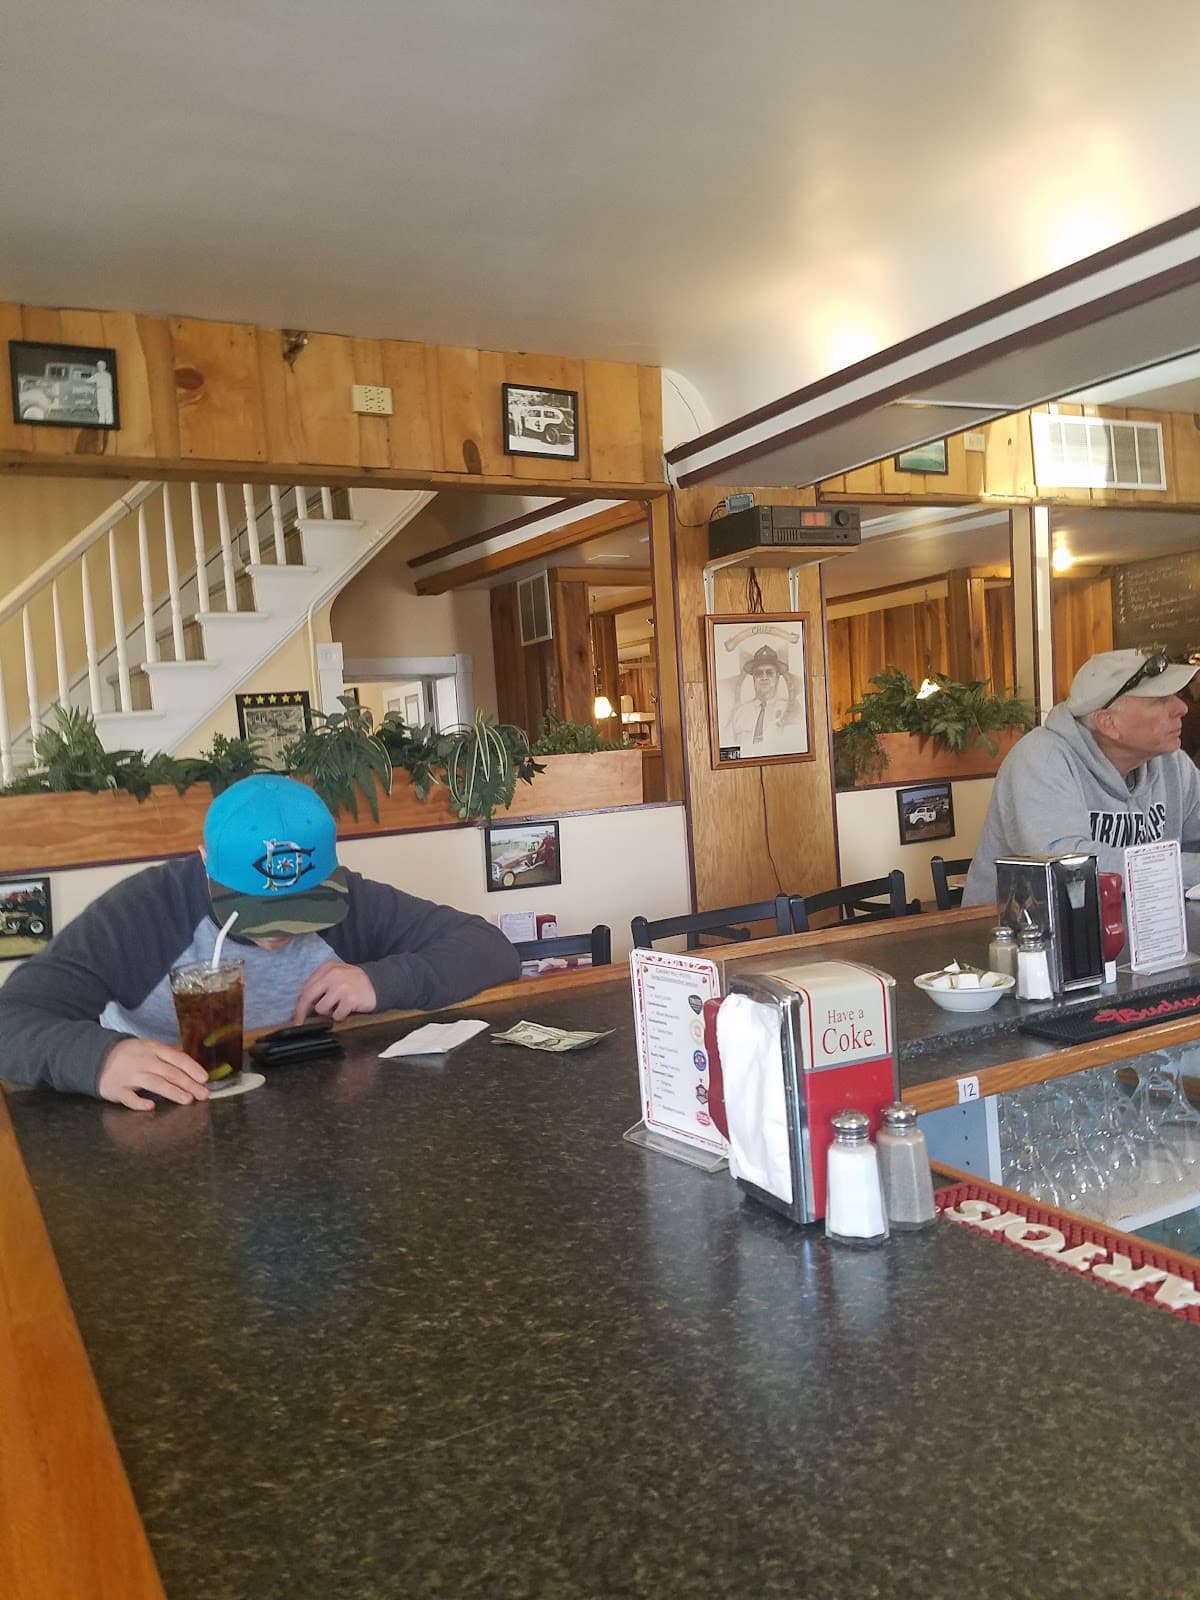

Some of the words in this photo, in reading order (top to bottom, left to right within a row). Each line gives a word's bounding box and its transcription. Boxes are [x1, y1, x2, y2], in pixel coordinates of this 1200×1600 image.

[827, 1009, 855, 1025] Have
[858, 1008, 865, 1019] a
[822, 1023, 874, 1055] Coke
[962, 1082, 977, 1097] 12
